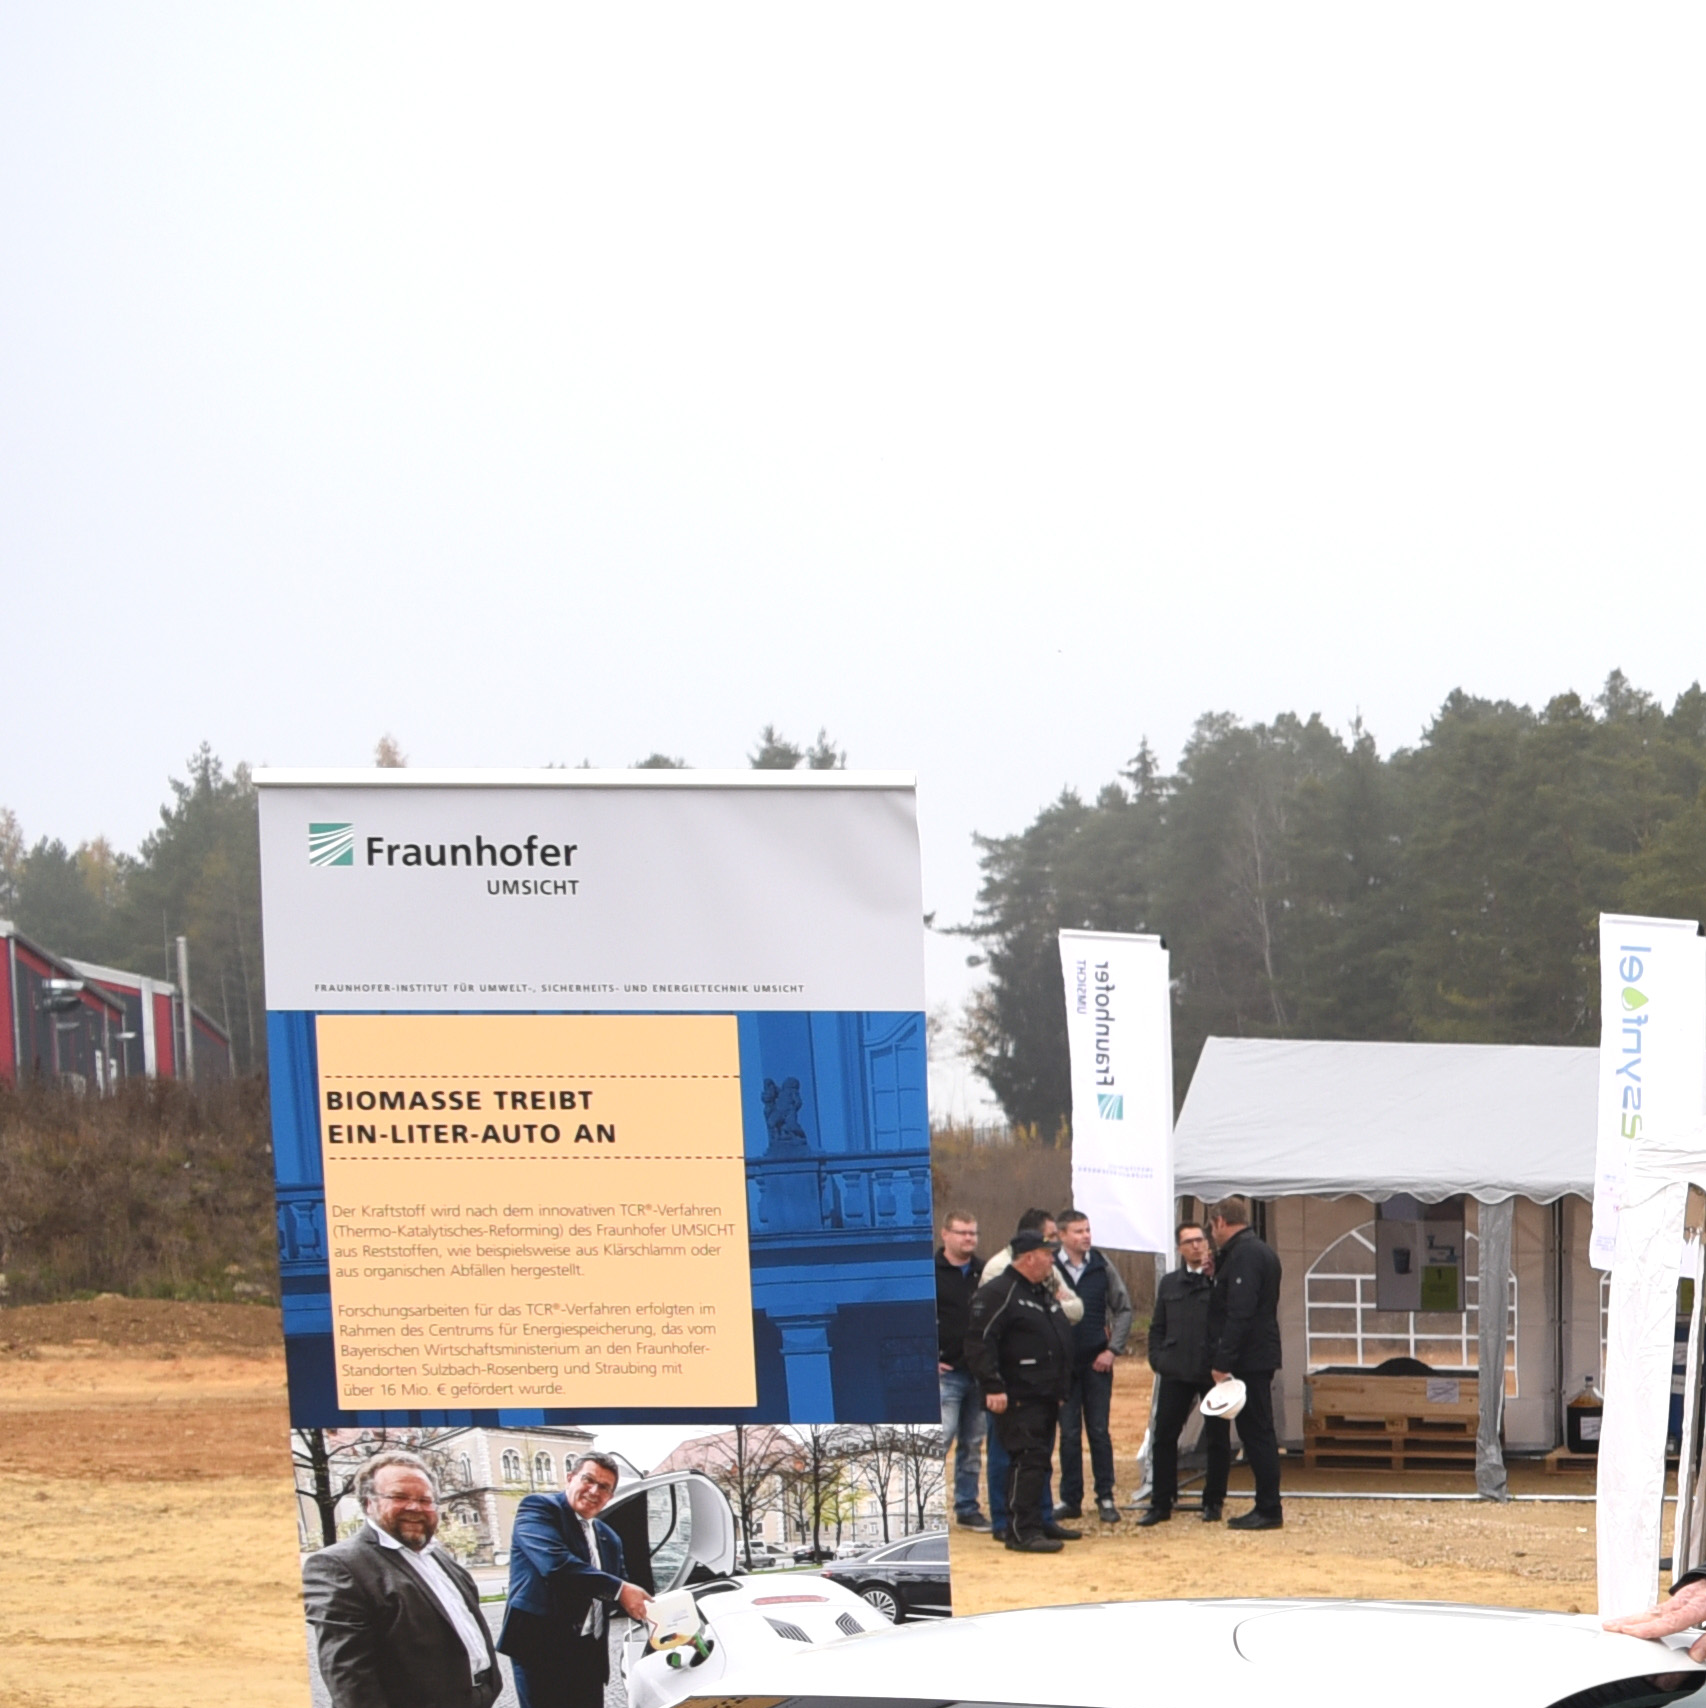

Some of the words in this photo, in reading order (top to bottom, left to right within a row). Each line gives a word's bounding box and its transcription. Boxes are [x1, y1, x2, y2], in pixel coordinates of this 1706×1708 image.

[366, 834, 578, 869] Fraunhofer
[486, 879, 580, 896] UMSICHT
[314, 983, 449, 993] FRAUNHOFER-INSTITUT
[453, 981, 475, 993] FÜR
[541, 983, 619, 993] SICHERHEITS-
[623, 983, 648, 993] UND
[652, 983, 750, 993] ENERGIETECHNIK
[753, 983, 806, 993] UMSICHT
[326, 1089, 482, 1111] BIOMASSE
[493, 1089, 594, 1110] TREIBT
[327, 1123, 562, 1144] EIN-LITER-AUTO
[573, 1122, 616, 1144] AN
[332, 1204, 357, 1218] Der
[361, 1204, 426, 1218] Kraftstoff
[431, 1204, 461, 1217] wird
[465, 1204, 498, 1217] nach
[503, 1204, 534, 1217] dem
[538, 1203, 616, 1217] innovativen
[333, 1223, 564, 1241] (Thermo-Katalytisches-Reforming)
[568, 1223, 592, 1237] des
[596, 1223, 667, 1237] Fraunhofer
[671, 1223, 736, 1237] UMSICHT
[334, 1246, 358, 1258] aus
[362, 1244, 443, 1259] Reststoffen,
[447, 1245, 472, 1258] wie
[476, 1243, 571, 1261] beispielsweise
[575, 1245, 599, 1257] aus
[603, 1243, 686, 1257] Klärschlamm
[690, 1243, 722, 1257] oder
[335, 1266, 359, 1278] aus
[363, 1264, 445, 1281] organischen
[449, 1263, 506, 1278] Abfällen
[510, 1263, 585, 1280] hergestellt.
[338, 1304, 470, 1320] Forschungsarbeiten
[474, 1303, 494, 1316] für
[498, 1303, 522, 1316] das
[635, 1302, 695, 1318] erfolgten
[699, 1302, 717, 1316] im
[340, 1324, 396, 1337] Rahmen
[400, 1324, 424, 1337] des
[428, 1323, 494, 1337] Centrums
[498, 1323, 518, 1336] für
[522, 1322, 657, 1338] Energiespeicherung,
[661, 1322, 684, 1335] das
[688, 1324, 717, 1335] vom
[340, 1344, 420, 1361] Bayerischen
[424, 1342, 581, 1357] Wirtschaftsministerium
[584, 1344, 602, 1355] an
[606, 1342, 632, 1355] den
[636, 1341, 711, 1355] Fraunhofer-
[342, 1363, 418, 1377] Standorten
[422, 1362, 559, 1378] Sulzbach-Rosenberg
[563, 1362, 590, 1375] und
[595, 1361, 657, 1377] Straubing
[661, 1361, 683, 1375] mit
[343, 1382, 376, 1397] über
[381, 1383, 397, 1396] 16
[401, 1383, 432, 1396] Mio.
[437, 1383, 447, 1396] €
[450, 1382, 515, 1399] gefördert
[519, 1382, 566, 1395] wurde.
